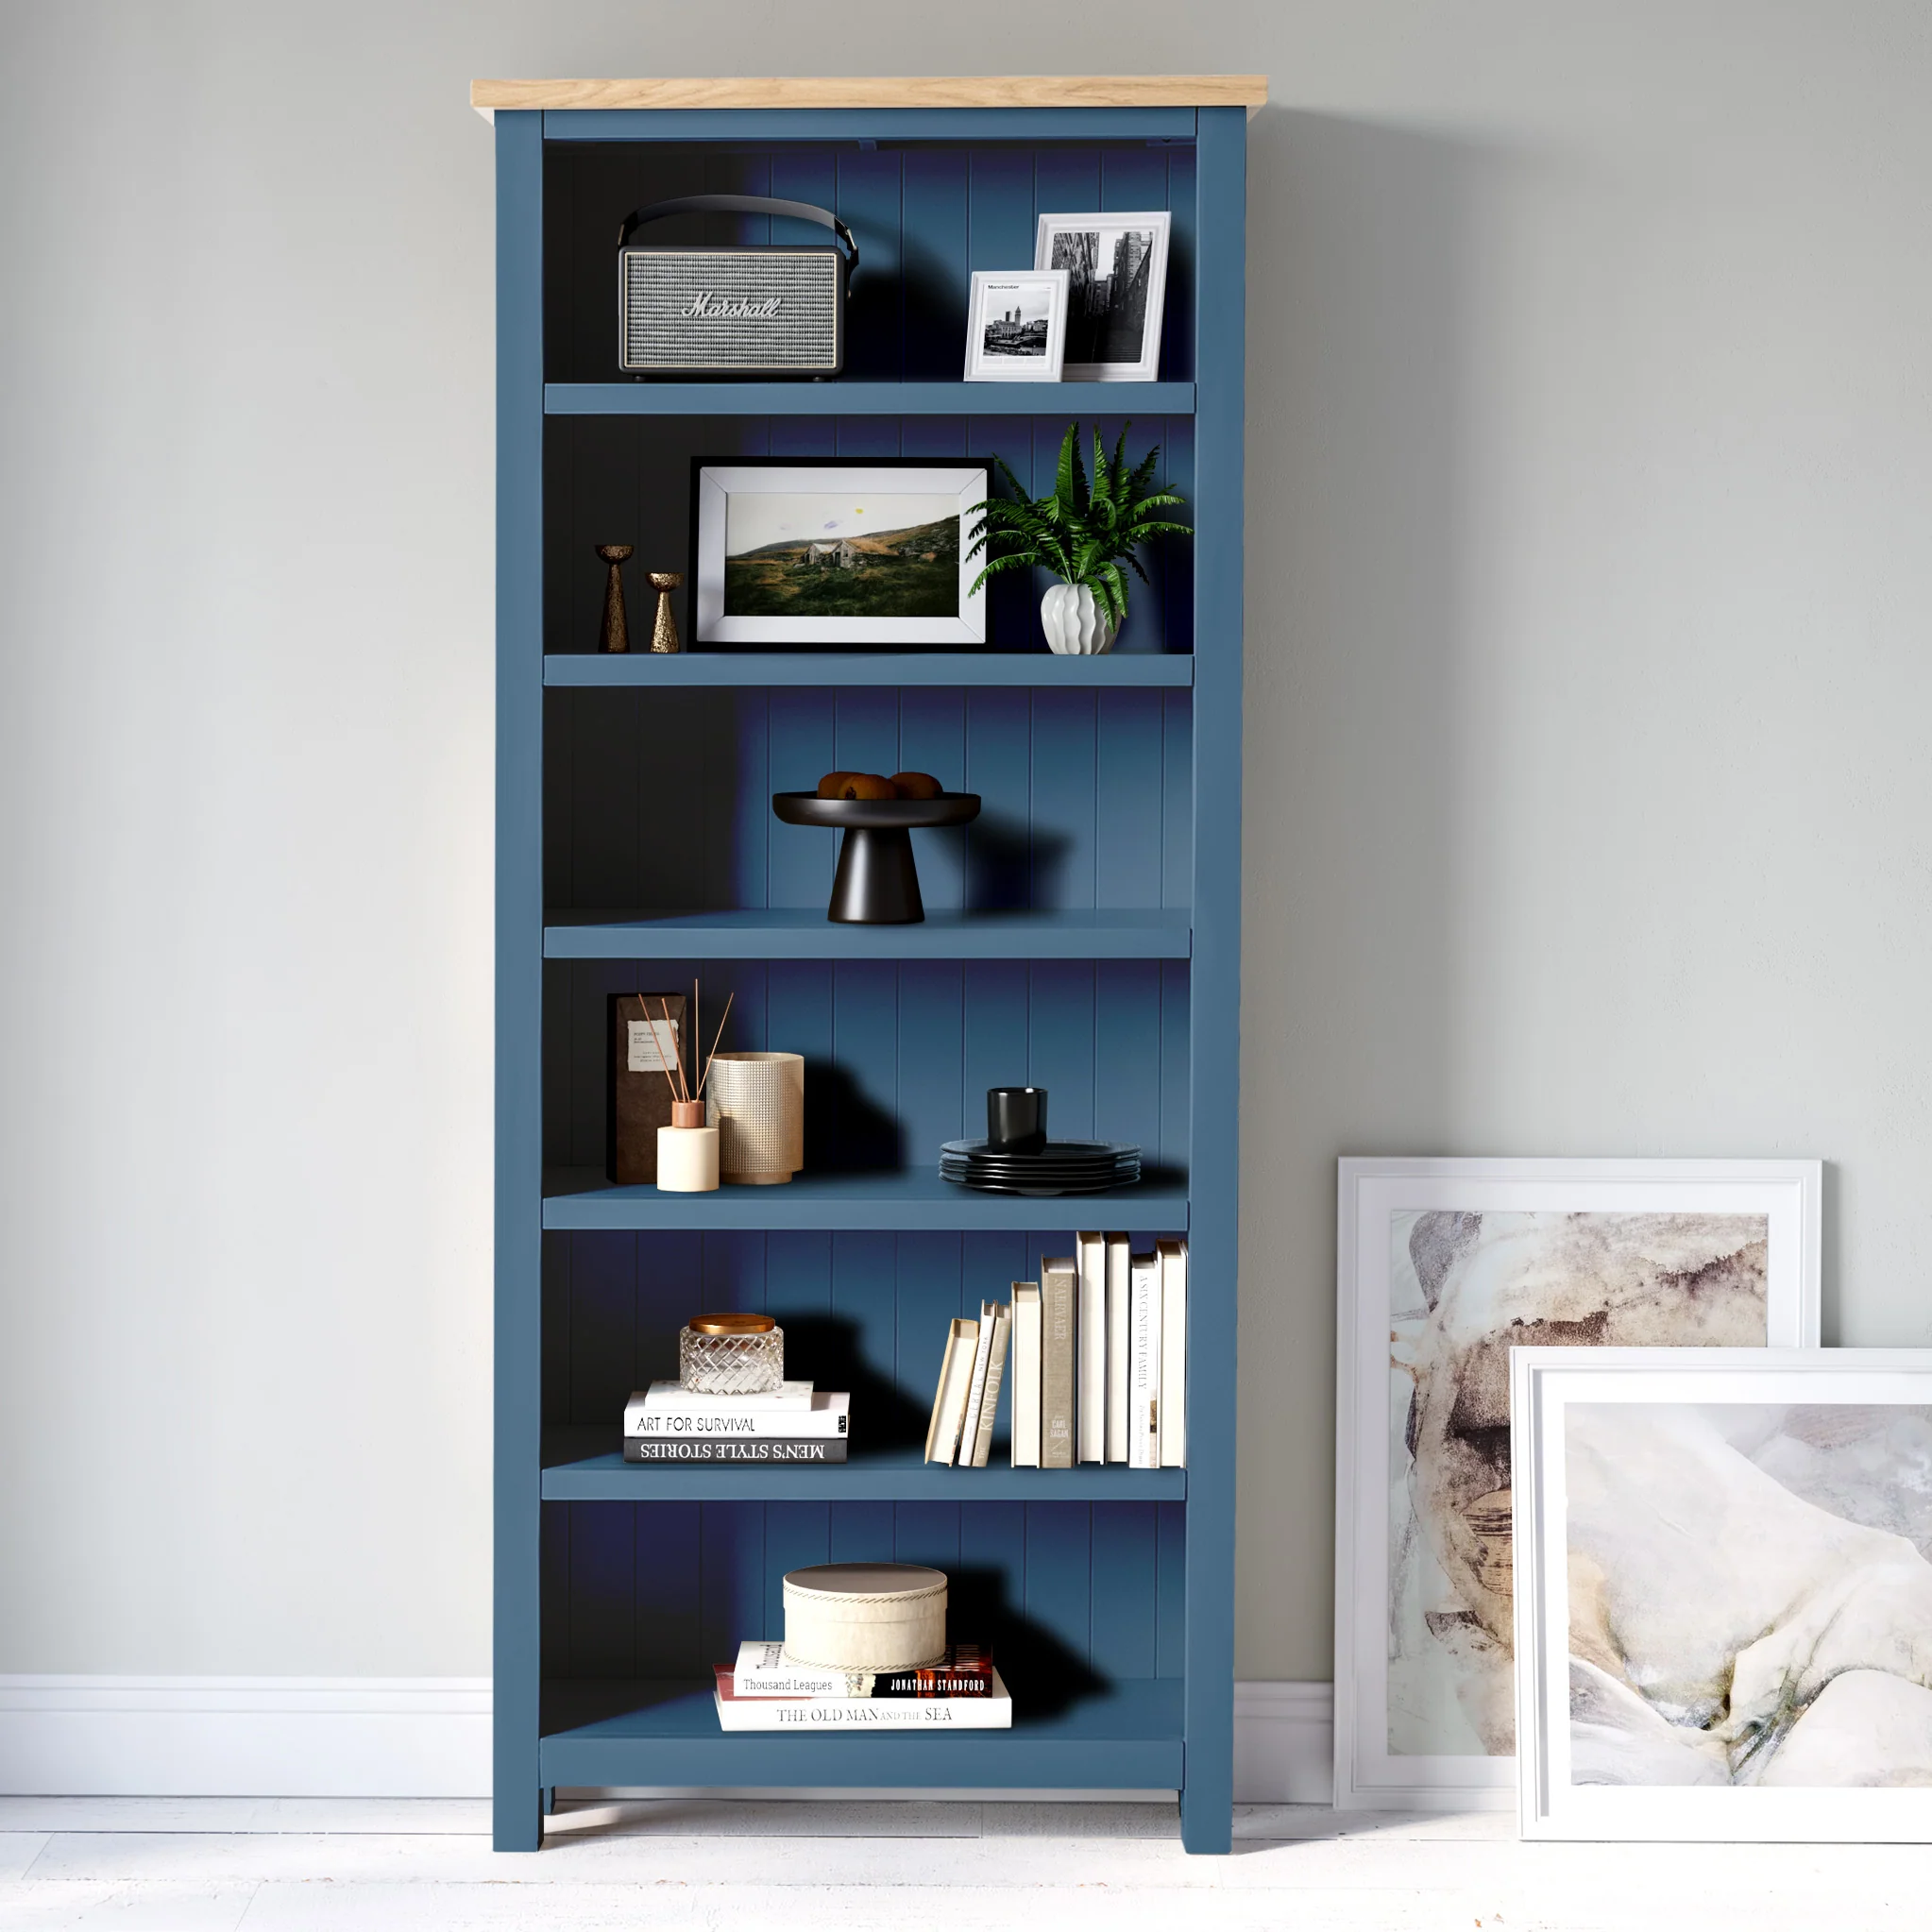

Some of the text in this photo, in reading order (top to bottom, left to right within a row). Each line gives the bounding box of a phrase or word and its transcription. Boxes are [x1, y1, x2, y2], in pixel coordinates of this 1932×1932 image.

[682, 291, 782, 317] Marshall
[1139, 1301, 1148, 1350] CENTURY
[1138, 1352, 1147, 1390] FAMILY
[970, 1379, 983, 1419] CEREAL
[980, 1362, 1003, 1432] KINFOLK
[637, 1417, 755, 1432] ART FOR SURVIVAL
[640, 1444, 824, 1459] MEN'S STYLE STORIES
[743, 1678, 833, 1692] Thousand Leagues
[890, 1679, 985, 1691] JONATHAN STANDFORD
[777, 1707, 953, 1721] THE OLD MAN AND THE SEA
